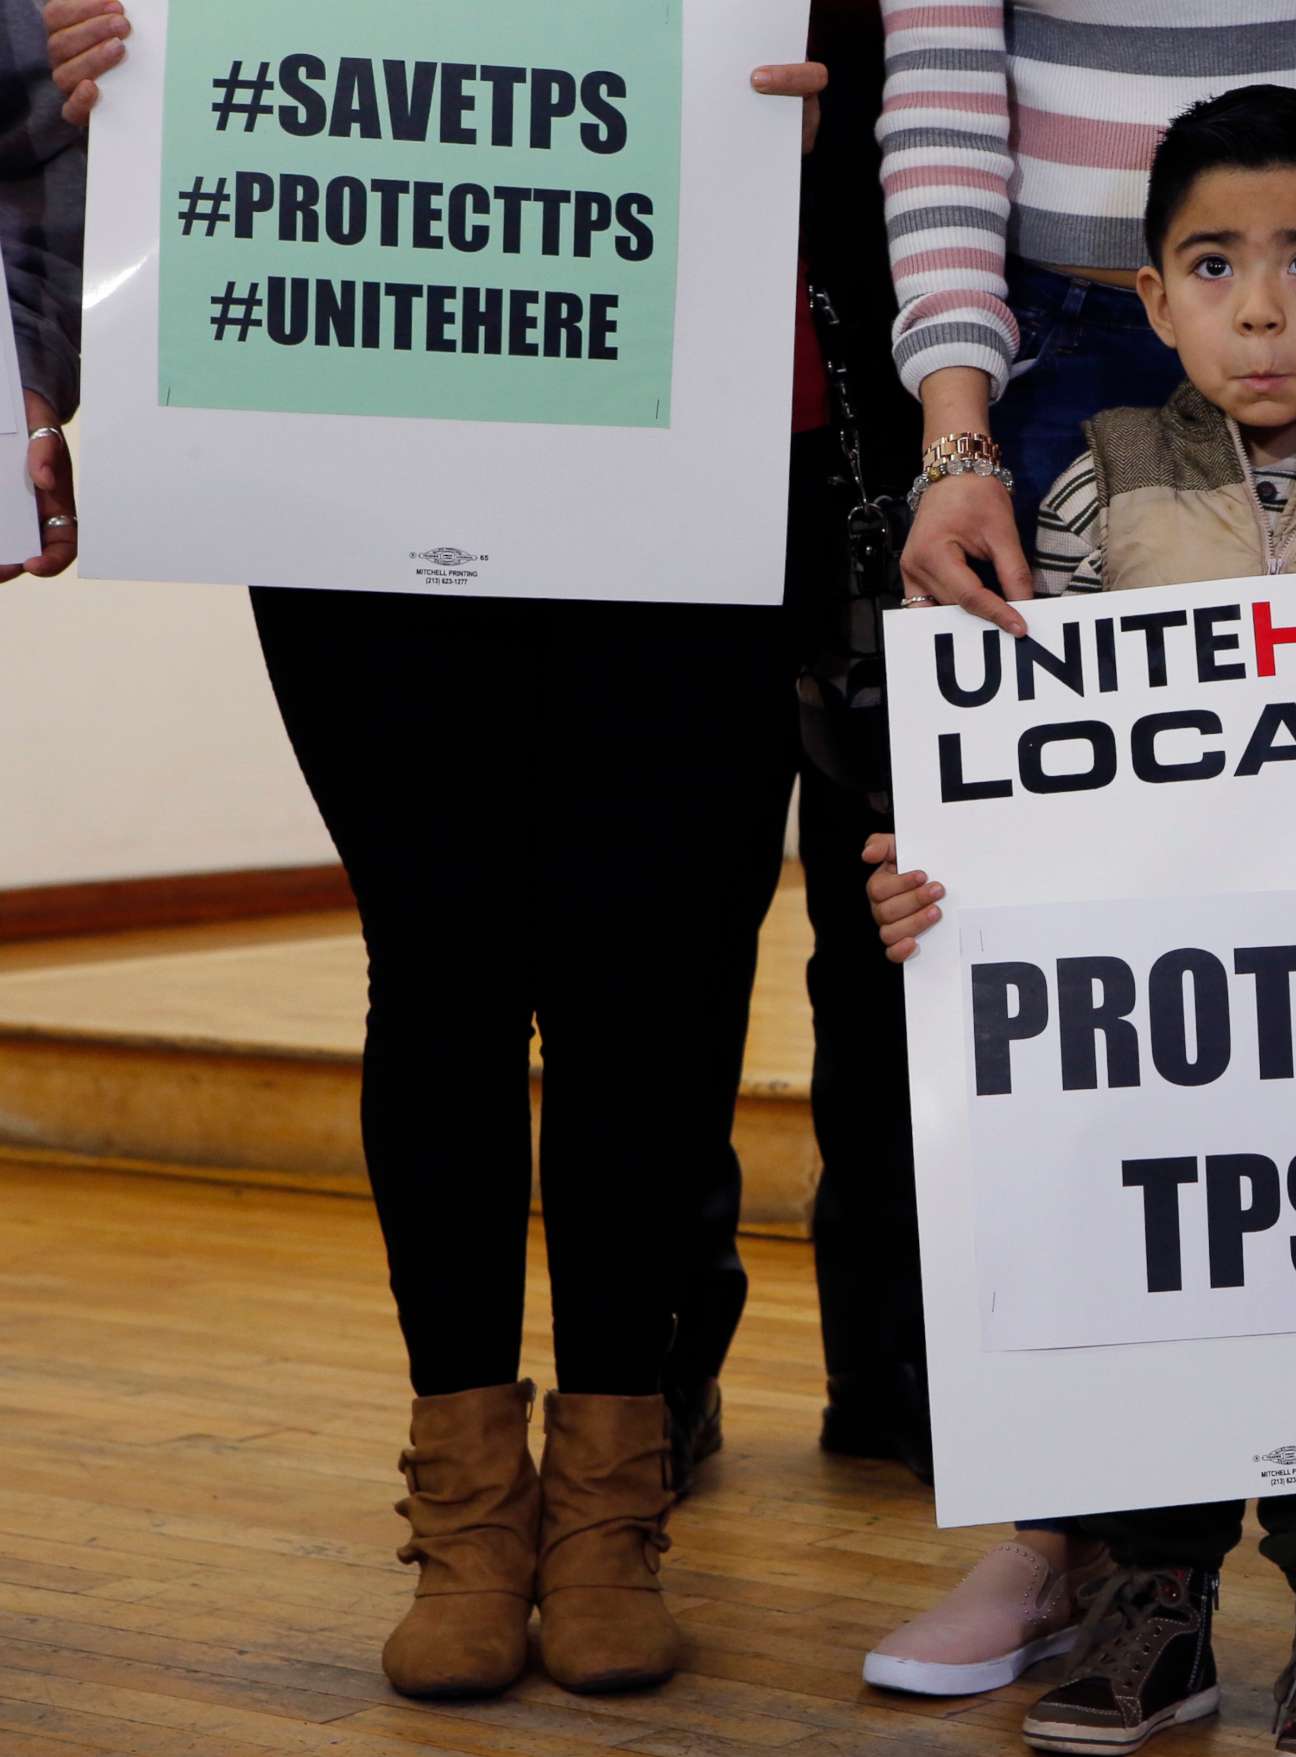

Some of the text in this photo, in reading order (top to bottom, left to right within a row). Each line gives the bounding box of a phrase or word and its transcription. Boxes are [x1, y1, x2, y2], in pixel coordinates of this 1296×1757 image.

[212, 54, 627, 154] #SAVETPS
[178, 171, 653, 261] #PROTECTTPS
[210, 276, 618, 360] #UNITEHERE
[416, 568, 447, 576] MITCHELL
[1261, 1469, 1291, 1477] MITCHELL
